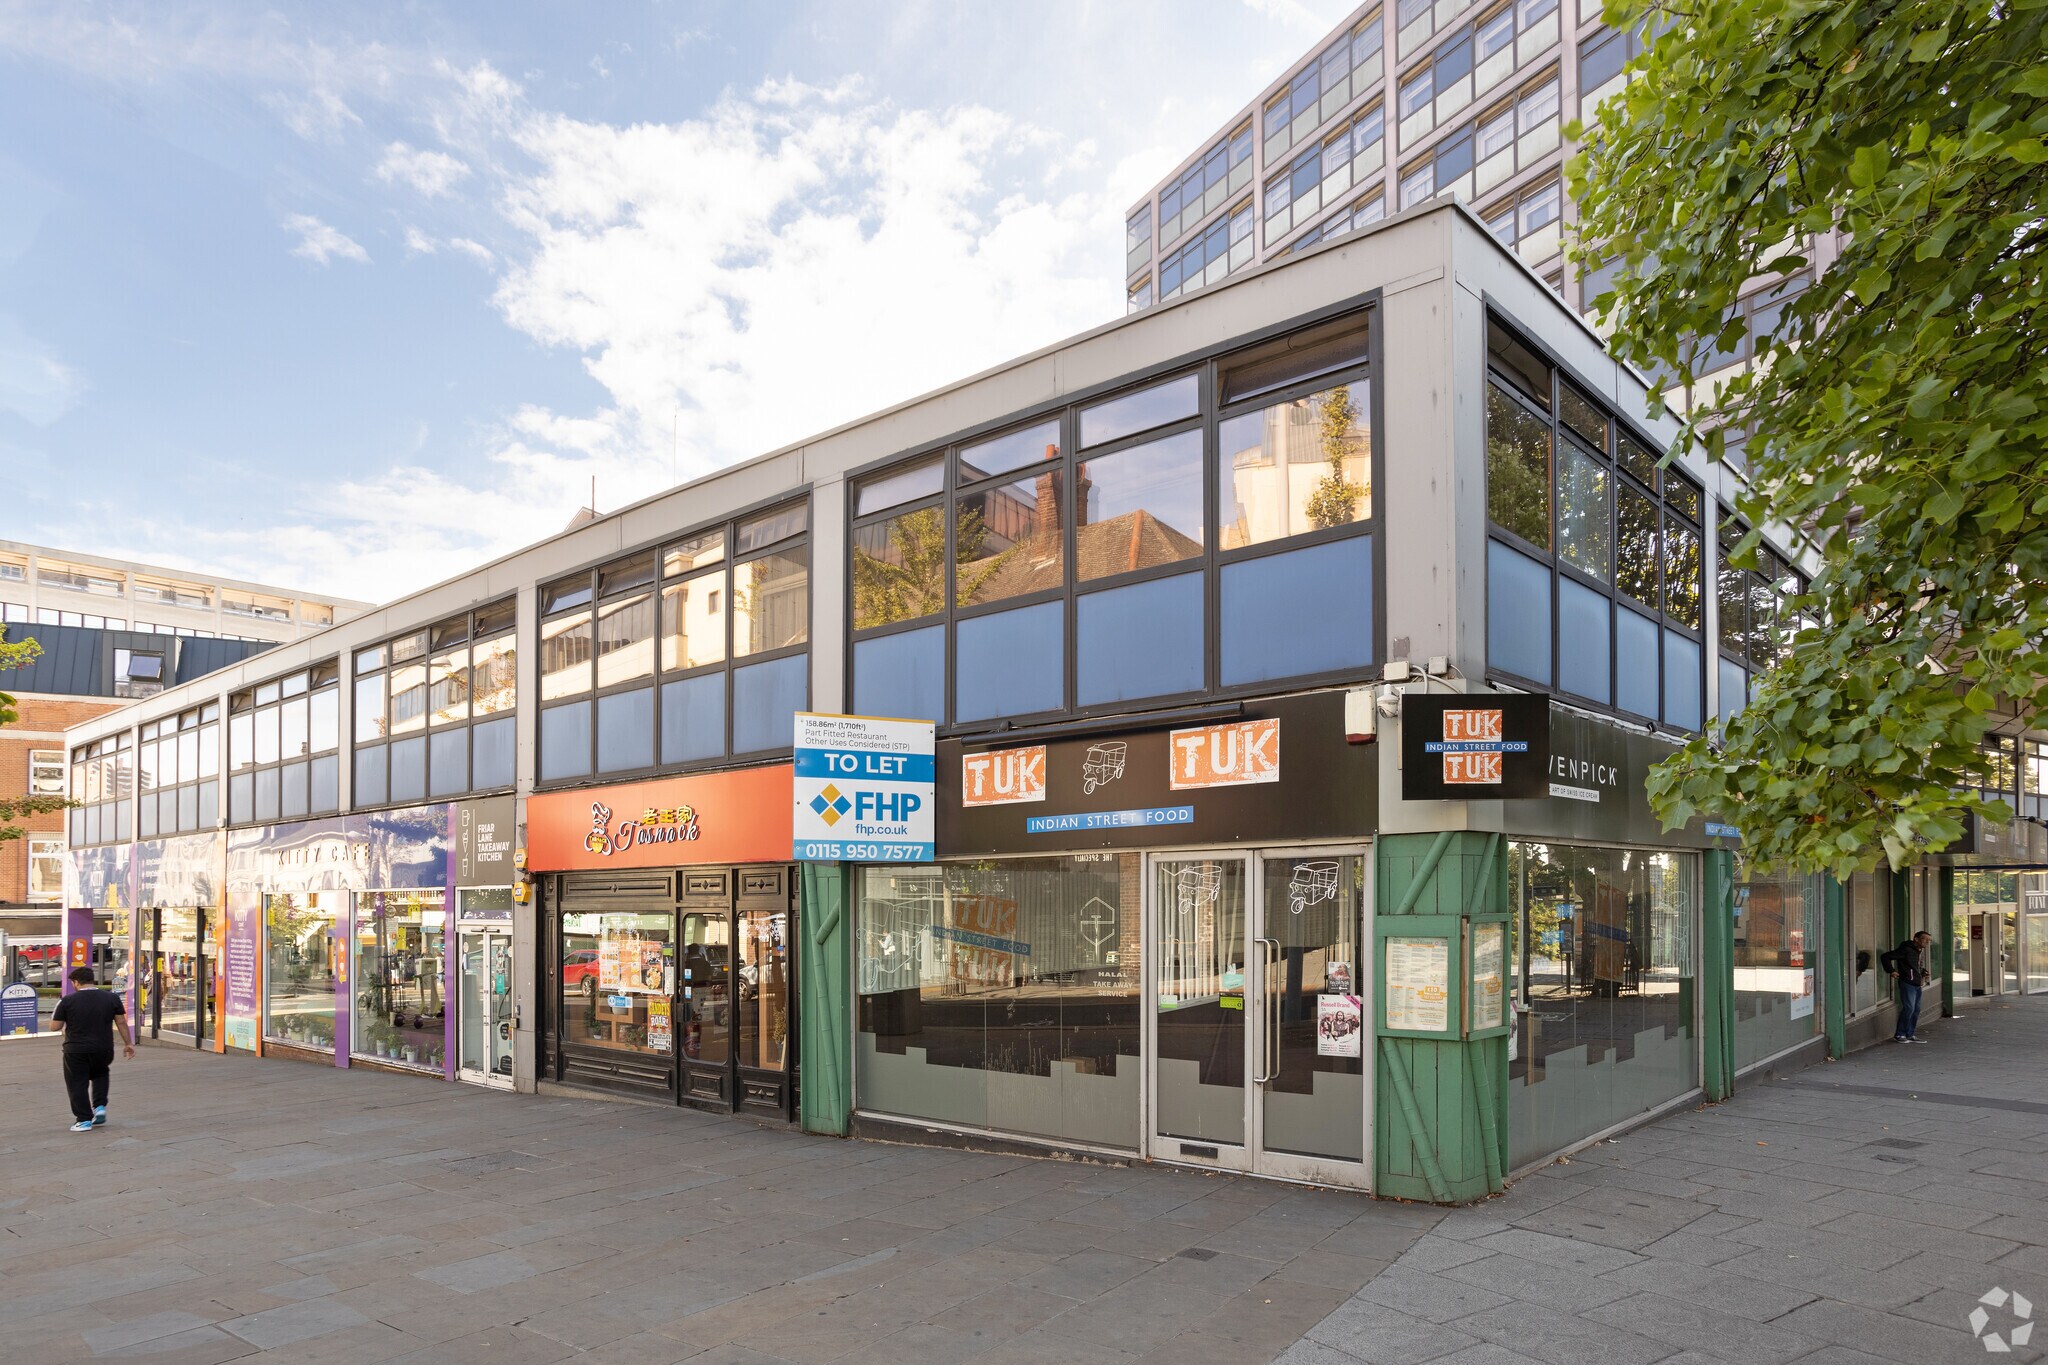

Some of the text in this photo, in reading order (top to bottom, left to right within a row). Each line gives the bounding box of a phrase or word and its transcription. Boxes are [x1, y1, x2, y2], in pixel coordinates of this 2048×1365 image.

[805, 728, 887, 741] Part Fitted Restaurant
[1447, 713, 1501, 737] TUK
[805, 737, 910, 752] Other Uses Considered (STP)
[1177, 728, 1278, 779] TUK
[1426, 743, 1527, 751] INDIAN STREET FOOD
[824, 753, 907, 775] TO LET
[1447, 756, 1501, 779] TUK
[967, 754, 1042, 797] TUK
[855, 791, 921, 822] FHP
[478, 823, 495, 833] FRIAR
[855, 824, 907, 836] fhp.co.uk
[1031, 809, 1189, 831] INDIAN STREET FOOD
[478, 833, 493, 843] LANE
[614, 814, 700, 851] Tasnack
[279, 843, 371, 865] KITTY CAFE
[478, 842, 510, 852] TAKEAWAY
[478, 852, 503, 862] KITCHEN
[806, 843, 923, 859] 0115 950 7577
[959, 900, 1017, 932] TUK
[967, 935, 997, 947] STREET
[1003, 942, 1028, 953] FOOD
[956, 949, 1012, 982] TUK
